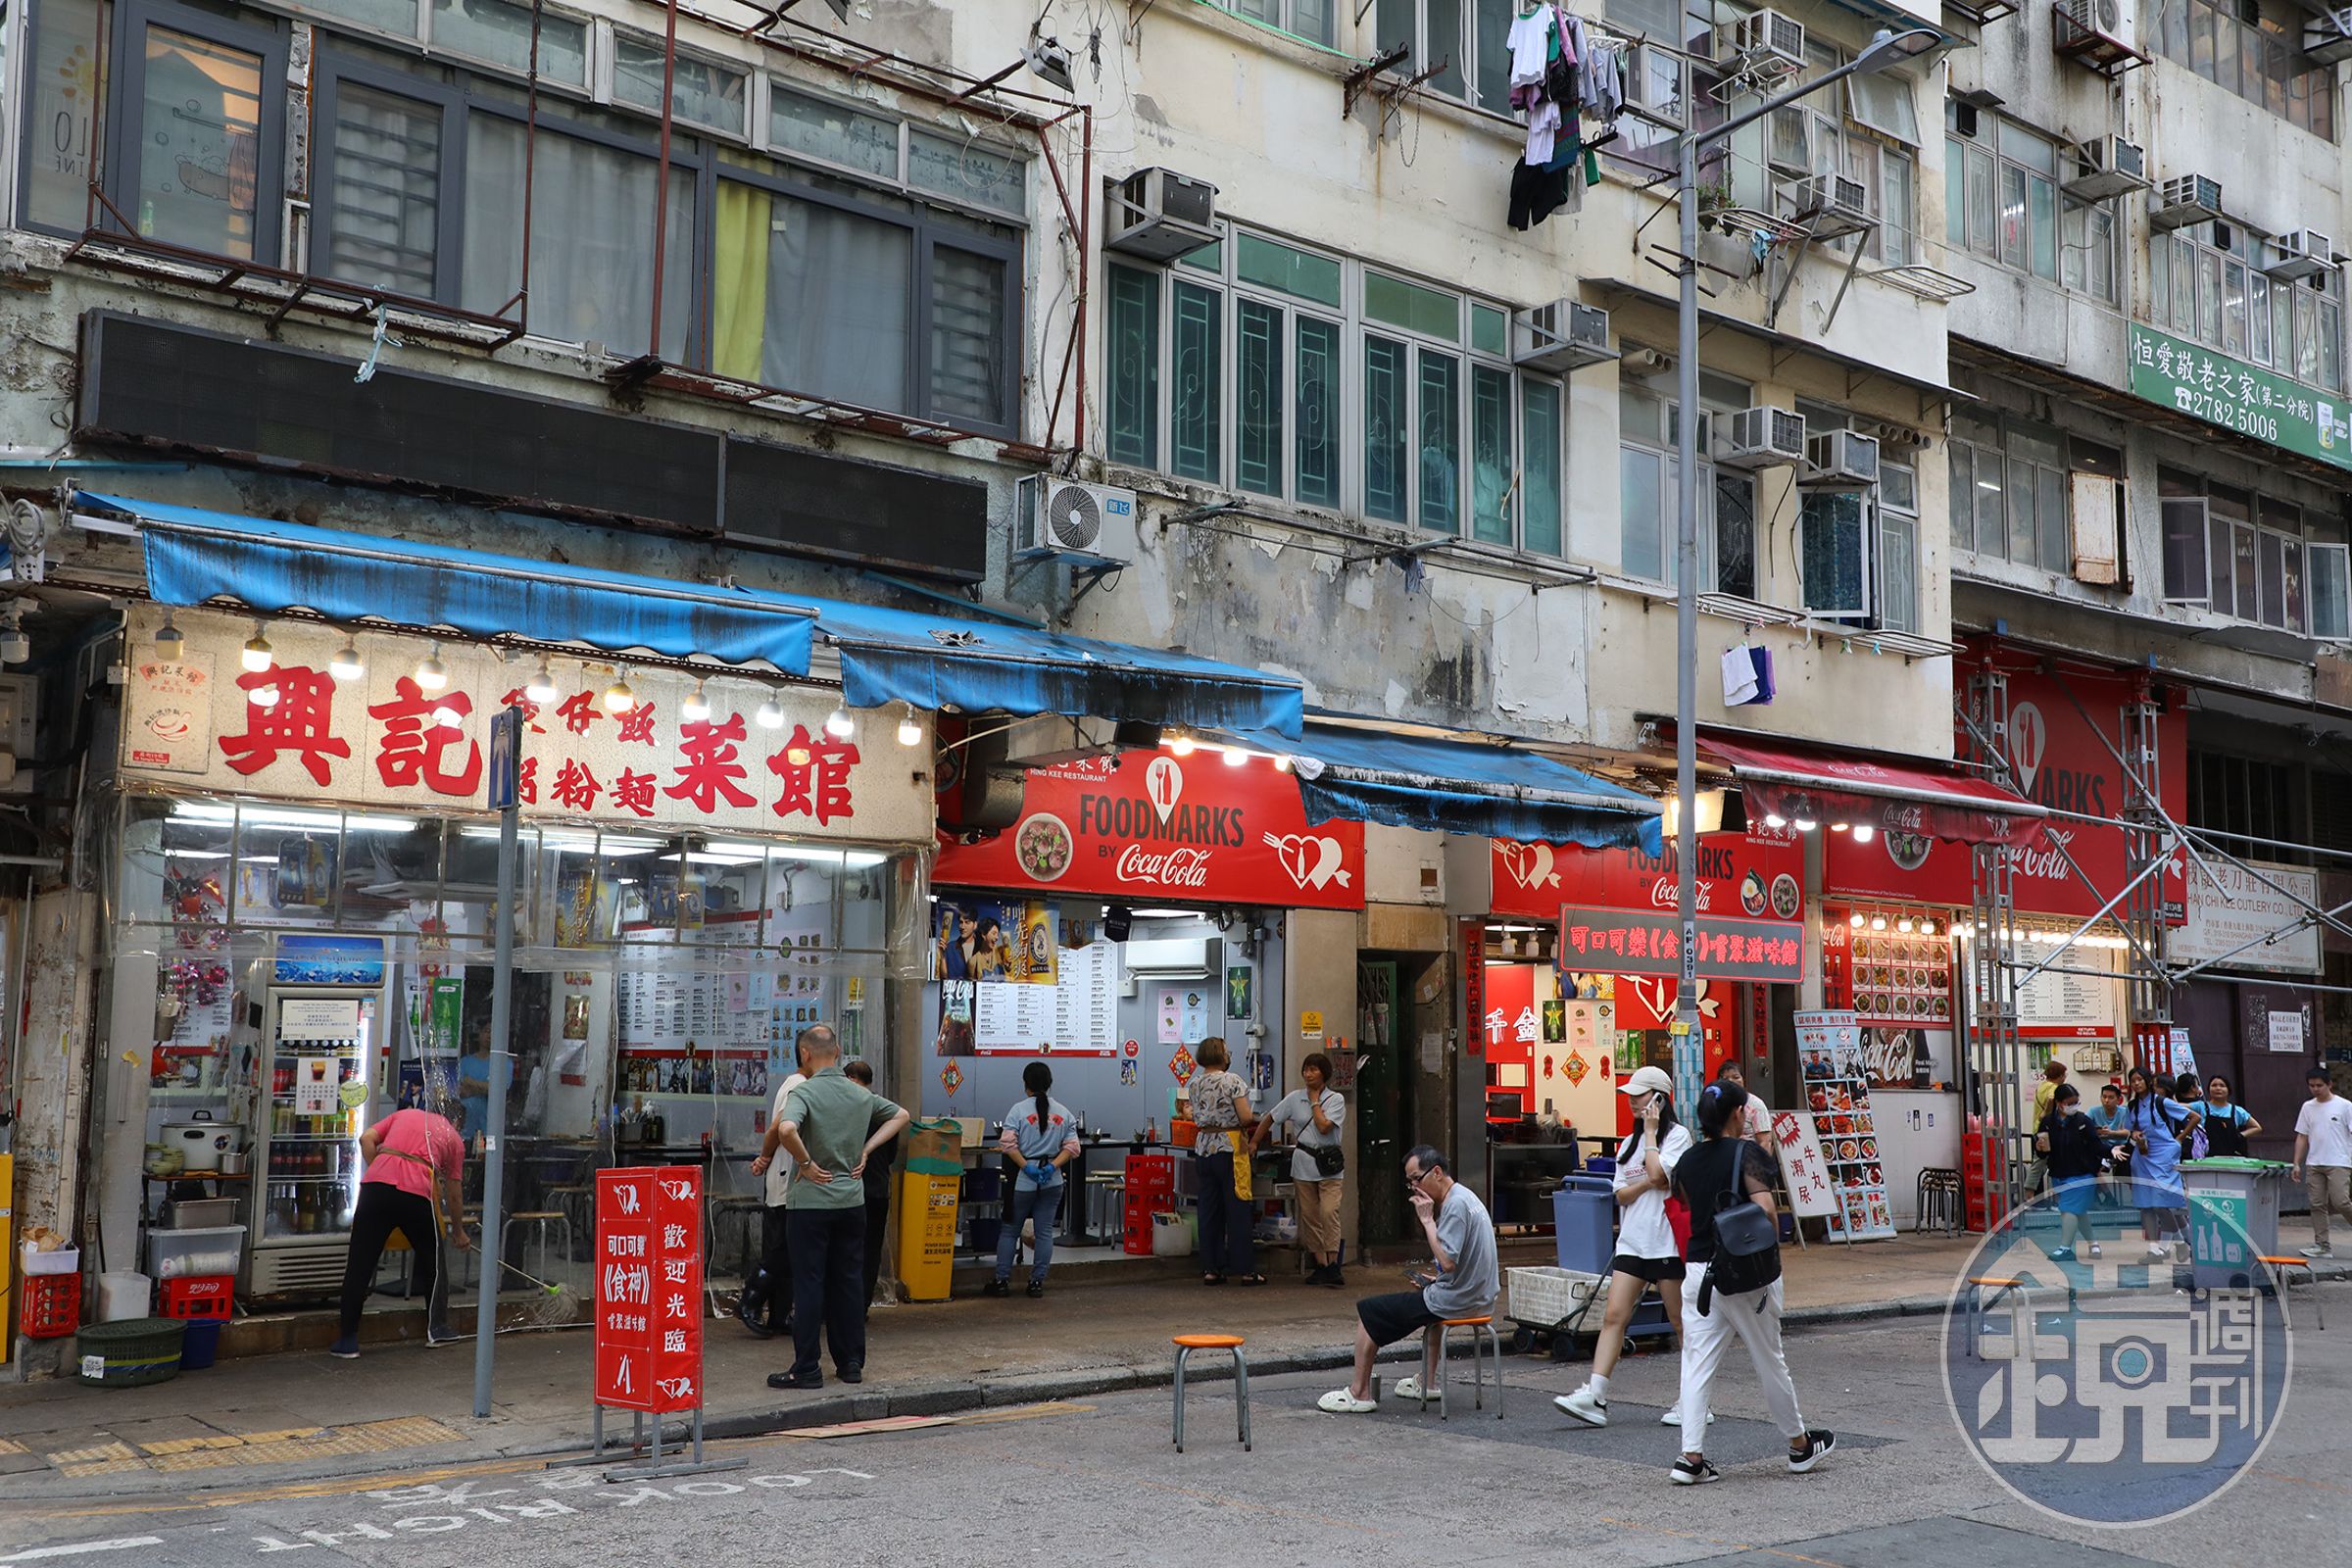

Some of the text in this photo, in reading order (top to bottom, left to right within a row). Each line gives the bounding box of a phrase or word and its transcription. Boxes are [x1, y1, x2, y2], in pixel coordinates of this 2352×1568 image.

[2194, 392, 2278, 441] 2782 5006
[218, 662, 482, 798] 興記
[662, 712, 861, 827] 菜館
[1063, 772, 1107, 783] RESTAURANT
[1080, 794, 1245, 848] FOODMARKS
[1099, 845, 1117, 858] BY
[1115, 844, 1214, 887] Coca-Cola
[1640, 878, 1652, 888] BY
[2237, 900, 2272, 912] CUTLERY
[608, 1235, 647, 1257] 可口可樂
[604, 1263, 650, 1304] 《食神》
[663, 1224, 687, 1352] 歡迎光臨
[251, 1468, 875, 1552] LOOK RIGHT
